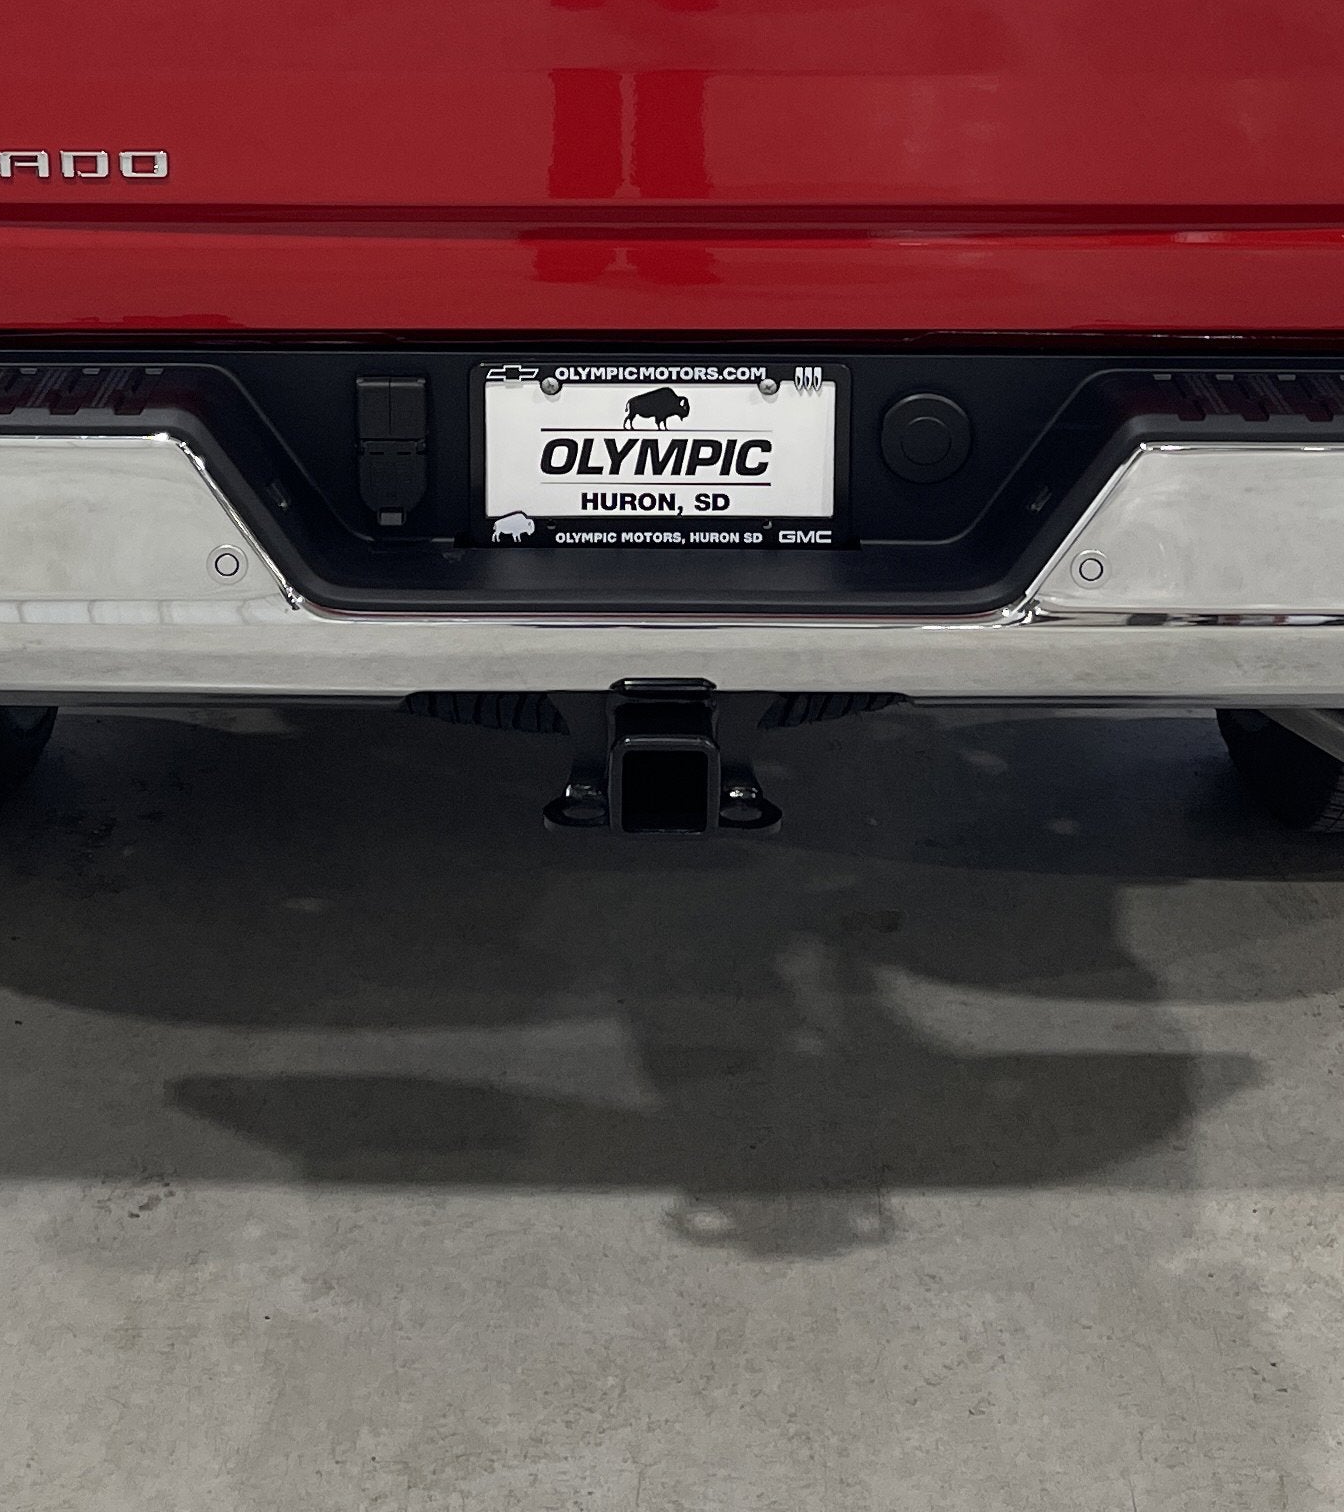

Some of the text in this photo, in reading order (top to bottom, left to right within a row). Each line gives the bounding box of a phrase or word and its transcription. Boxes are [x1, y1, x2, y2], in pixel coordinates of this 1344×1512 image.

[555, 366, 767, 381] OLYMPICMOTORS.COM
[540, 438, 772, 476] OLYMPIC
[581, 493, 730, 517] HURON, SD
[556, 530, 832, 545] OLYMPIC MOTORS, HURON SD GMC
